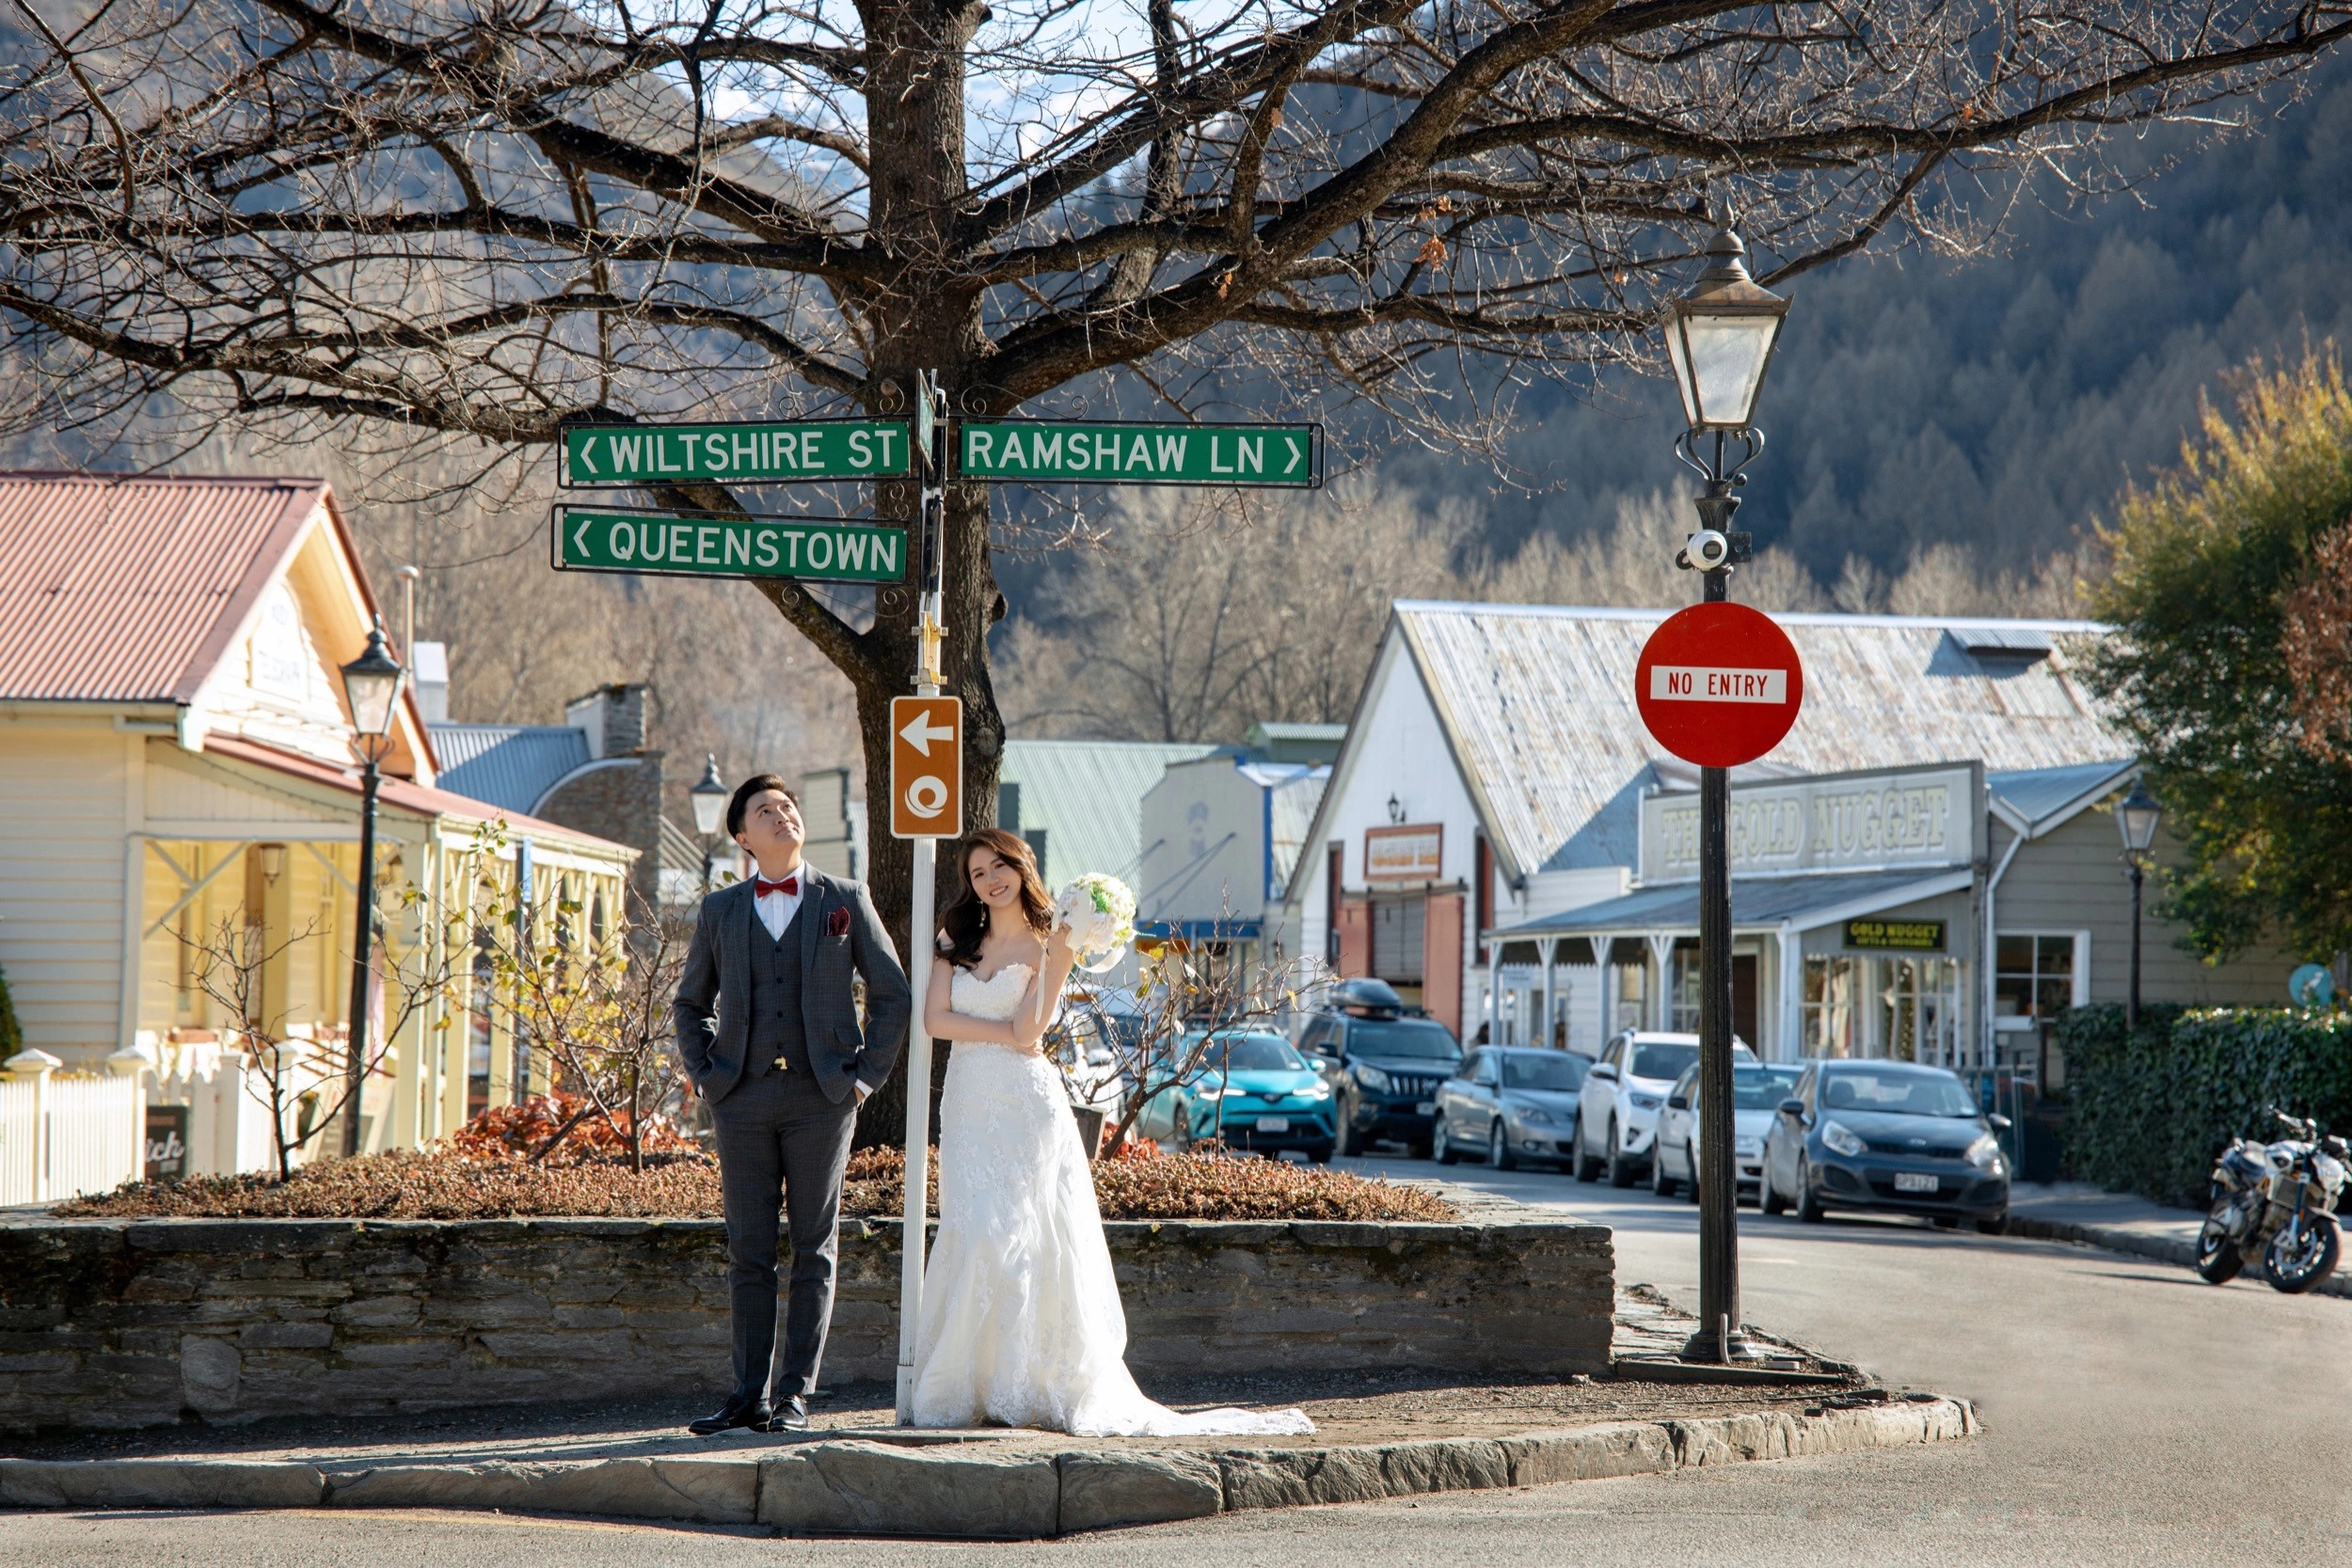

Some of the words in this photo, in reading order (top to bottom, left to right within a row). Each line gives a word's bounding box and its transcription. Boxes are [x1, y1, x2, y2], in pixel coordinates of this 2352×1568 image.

[610, 431, 825, 472] WILTSHIRE
[848, 430, 898, 467] ST
[968, 431, 1187, 472] RAMSHAW
[1211, 436, 1263, 474] LN
[609, 521, 898, 572] QUEENSTOWN
[1668, 672, 1692, 694] NO
[1708, 673, 1768, 697] ENTRY
[1662, 807, 1701, 862] TH
[1730, 799, 1801, 859] GOLD
[1813, 786, 1947, 853] NUGGET
[1850, 922, 1884, 937] GOLD
[1886, 924, 1939, 939] NUGGET
